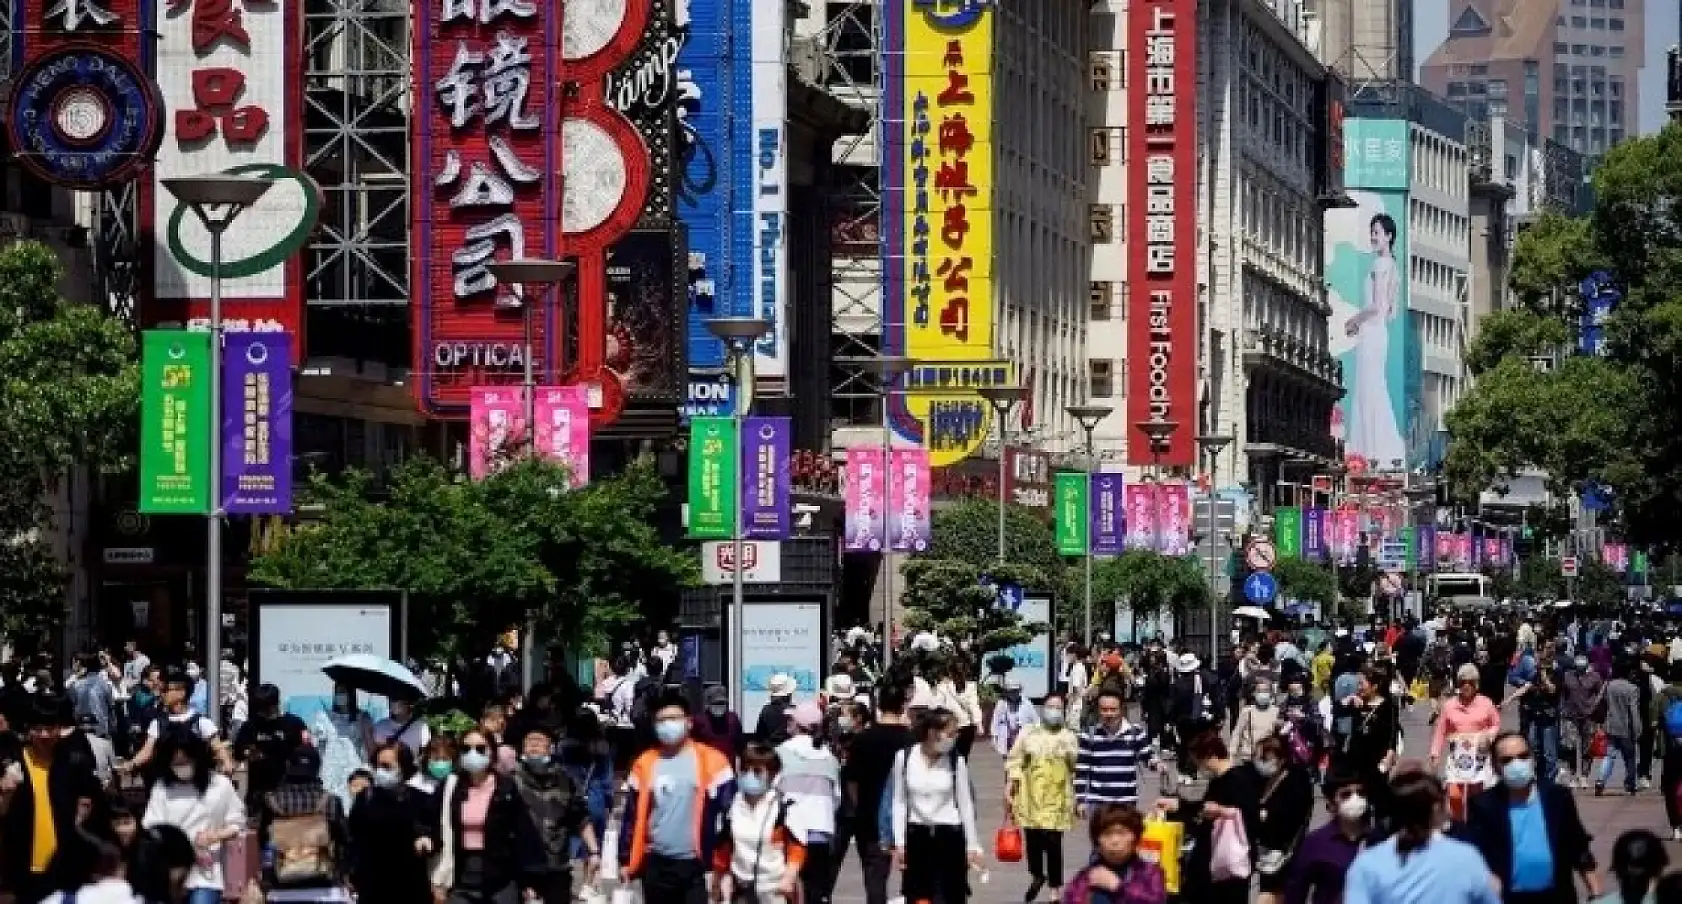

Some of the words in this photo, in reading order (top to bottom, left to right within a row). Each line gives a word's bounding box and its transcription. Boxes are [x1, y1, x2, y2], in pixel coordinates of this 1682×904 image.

[434, 0, 541, 307] 镜公司
[1145, 6, 1175, 272] 上海市第一食品商店
[757, 213, 779, 359] Pharmay
[1150, 289, 1172, 336] First
